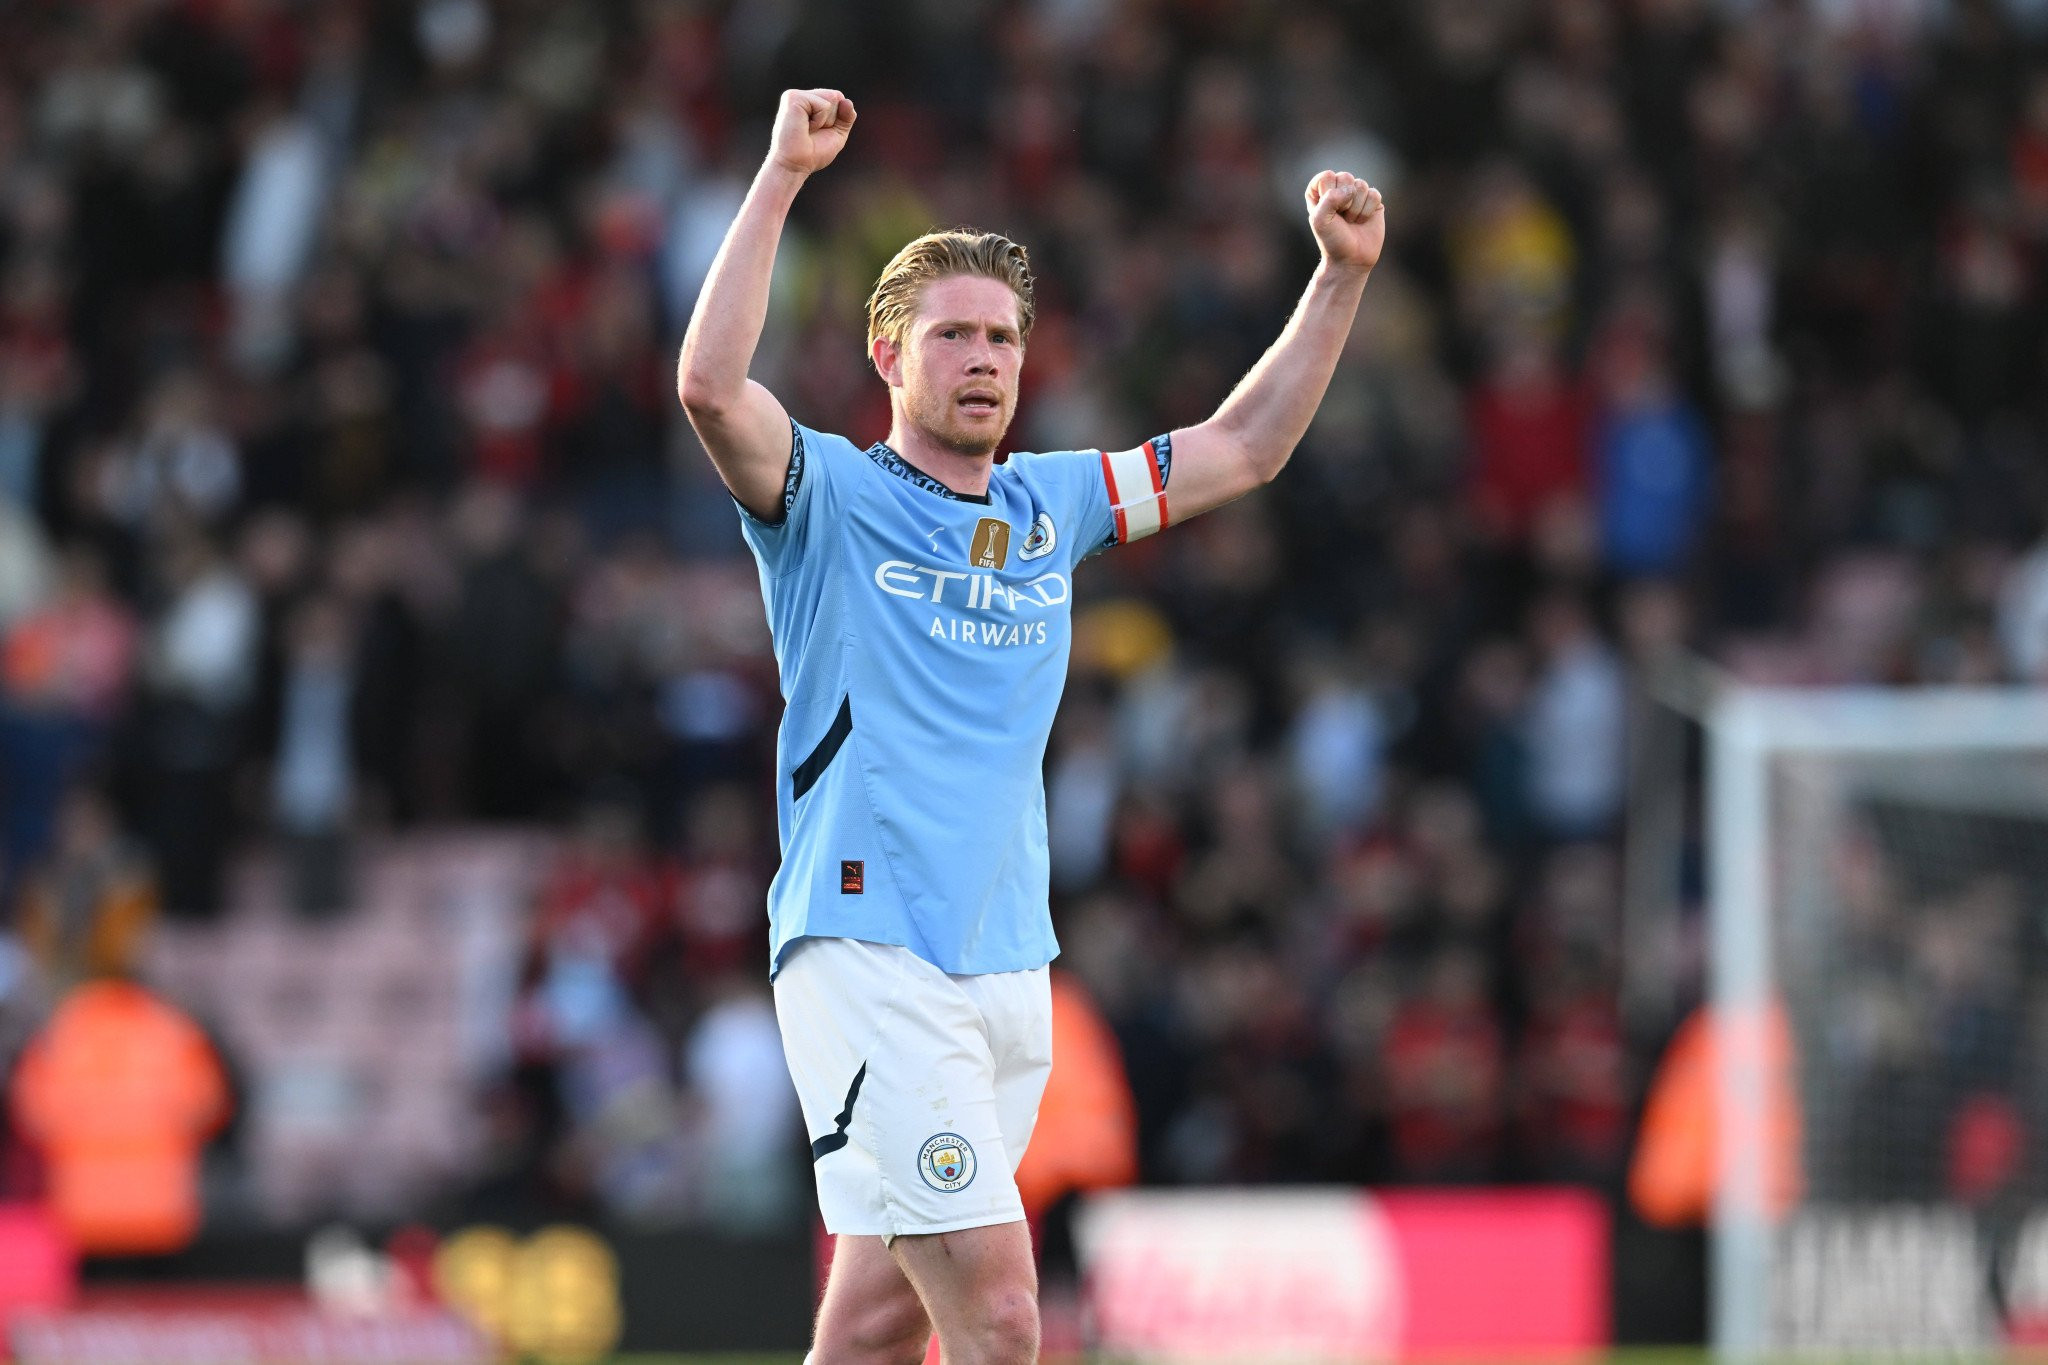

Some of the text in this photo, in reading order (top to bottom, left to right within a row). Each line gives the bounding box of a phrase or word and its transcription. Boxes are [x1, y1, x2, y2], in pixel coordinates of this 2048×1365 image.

[978, 557, 995, 569] FIFA
[874, 560, 1068, 611] ETIHAD
[930, 616, 1047, 646] AIRWAYS
[923, 1137, 968, 1160] MANCHESTER
[944, 1181, 962, 1190] CITY
